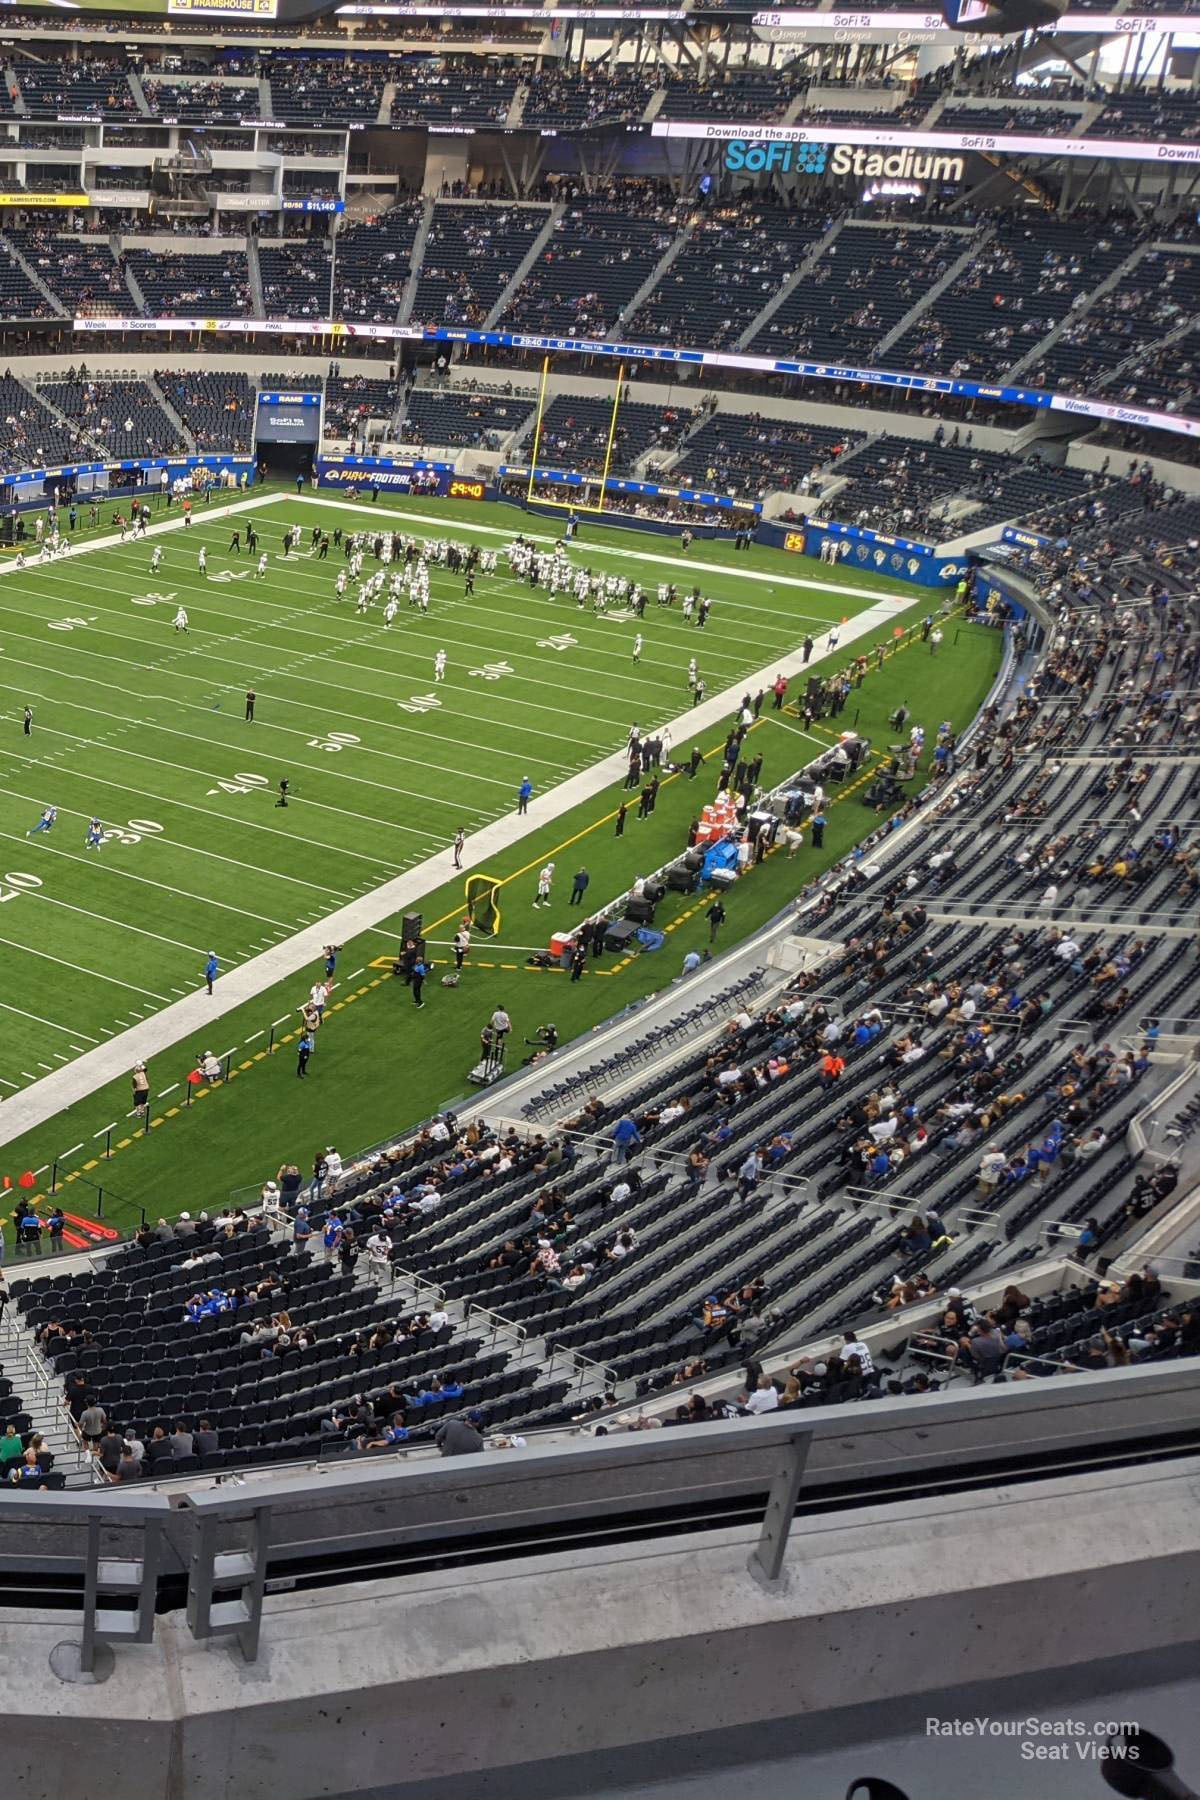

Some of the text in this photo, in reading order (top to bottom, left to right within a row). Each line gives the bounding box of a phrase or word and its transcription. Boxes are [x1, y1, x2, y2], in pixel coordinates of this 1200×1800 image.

[834, 15, 858, 26] SoFi
[1115, 19, 1142, 31] SoFi
[706, 126, 809, 142] Download the app.
[961, 136, 985, 148] SoFi
[725, 139, 965, 181] SoFi Stadium
[307, 202, 336, 211] $11,140
[85, 321, 107, 329] Week
[130, 321, 157, 329] Scores
[243, 322, 249, 330] 0
[520, 337, 542, 346] 29:40
[674, 350, 680, 359] 0
[798, 364, 804, 373] 0
[977, 387, 1002, 397] RAMS
[1064, 400, 1149, 423] Week Scores
[392, 460, 414, 468] RAMS
[506, 467, 528, 476] RAMS
[450, 482, 482, 497] 29:40
[657, 487, 680, 497] RAMS
[732, 499, 754, 510] RAMS
[807, 518, 829, 529] RAMS
[786, 533, 801, 549] 25
[874, 534, 896, 545] RAMS
[1015, 533, 1039, 548] RAMS
[535, 634, 578, 651] 20
[468, 664, 515, 681] 30
[397, 694, 443, 714] 40
[306, 730, 362, 753] 50
[217, 772, 270, 796] 40
[106, 818, 164, 845] 30
